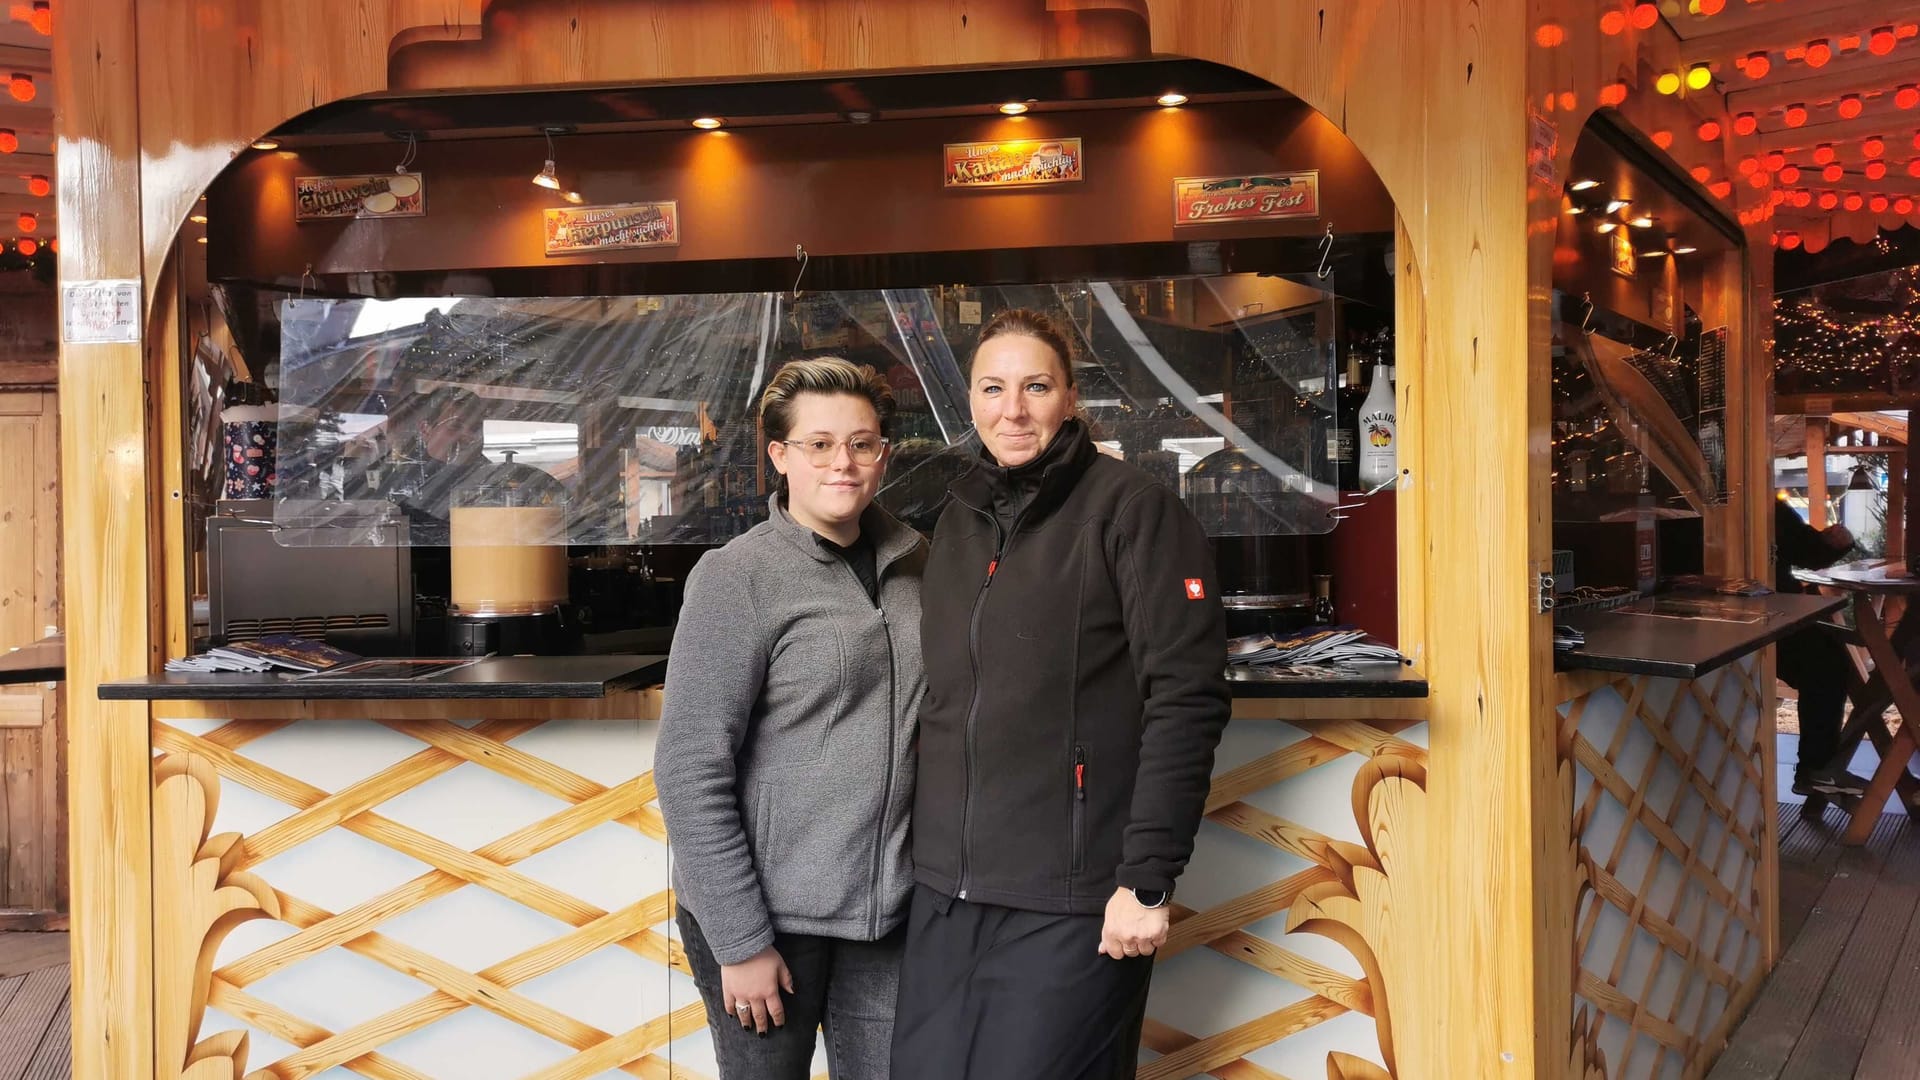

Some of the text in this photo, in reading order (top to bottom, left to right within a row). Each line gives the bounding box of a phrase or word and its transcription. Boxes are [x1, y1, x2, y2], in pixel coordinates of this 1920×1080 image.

[954, 151, 1025, 180] Kakao
[1001, 164, 1036, 182] macht
[299, 176, 391, 209] Glühwein
[1259, 192, 1305, 213] Fest
[566, 204, 663, 243] Eierpunsch
[583, 208, 616, 224] Unser
[597, 229, 631, 246] macht
